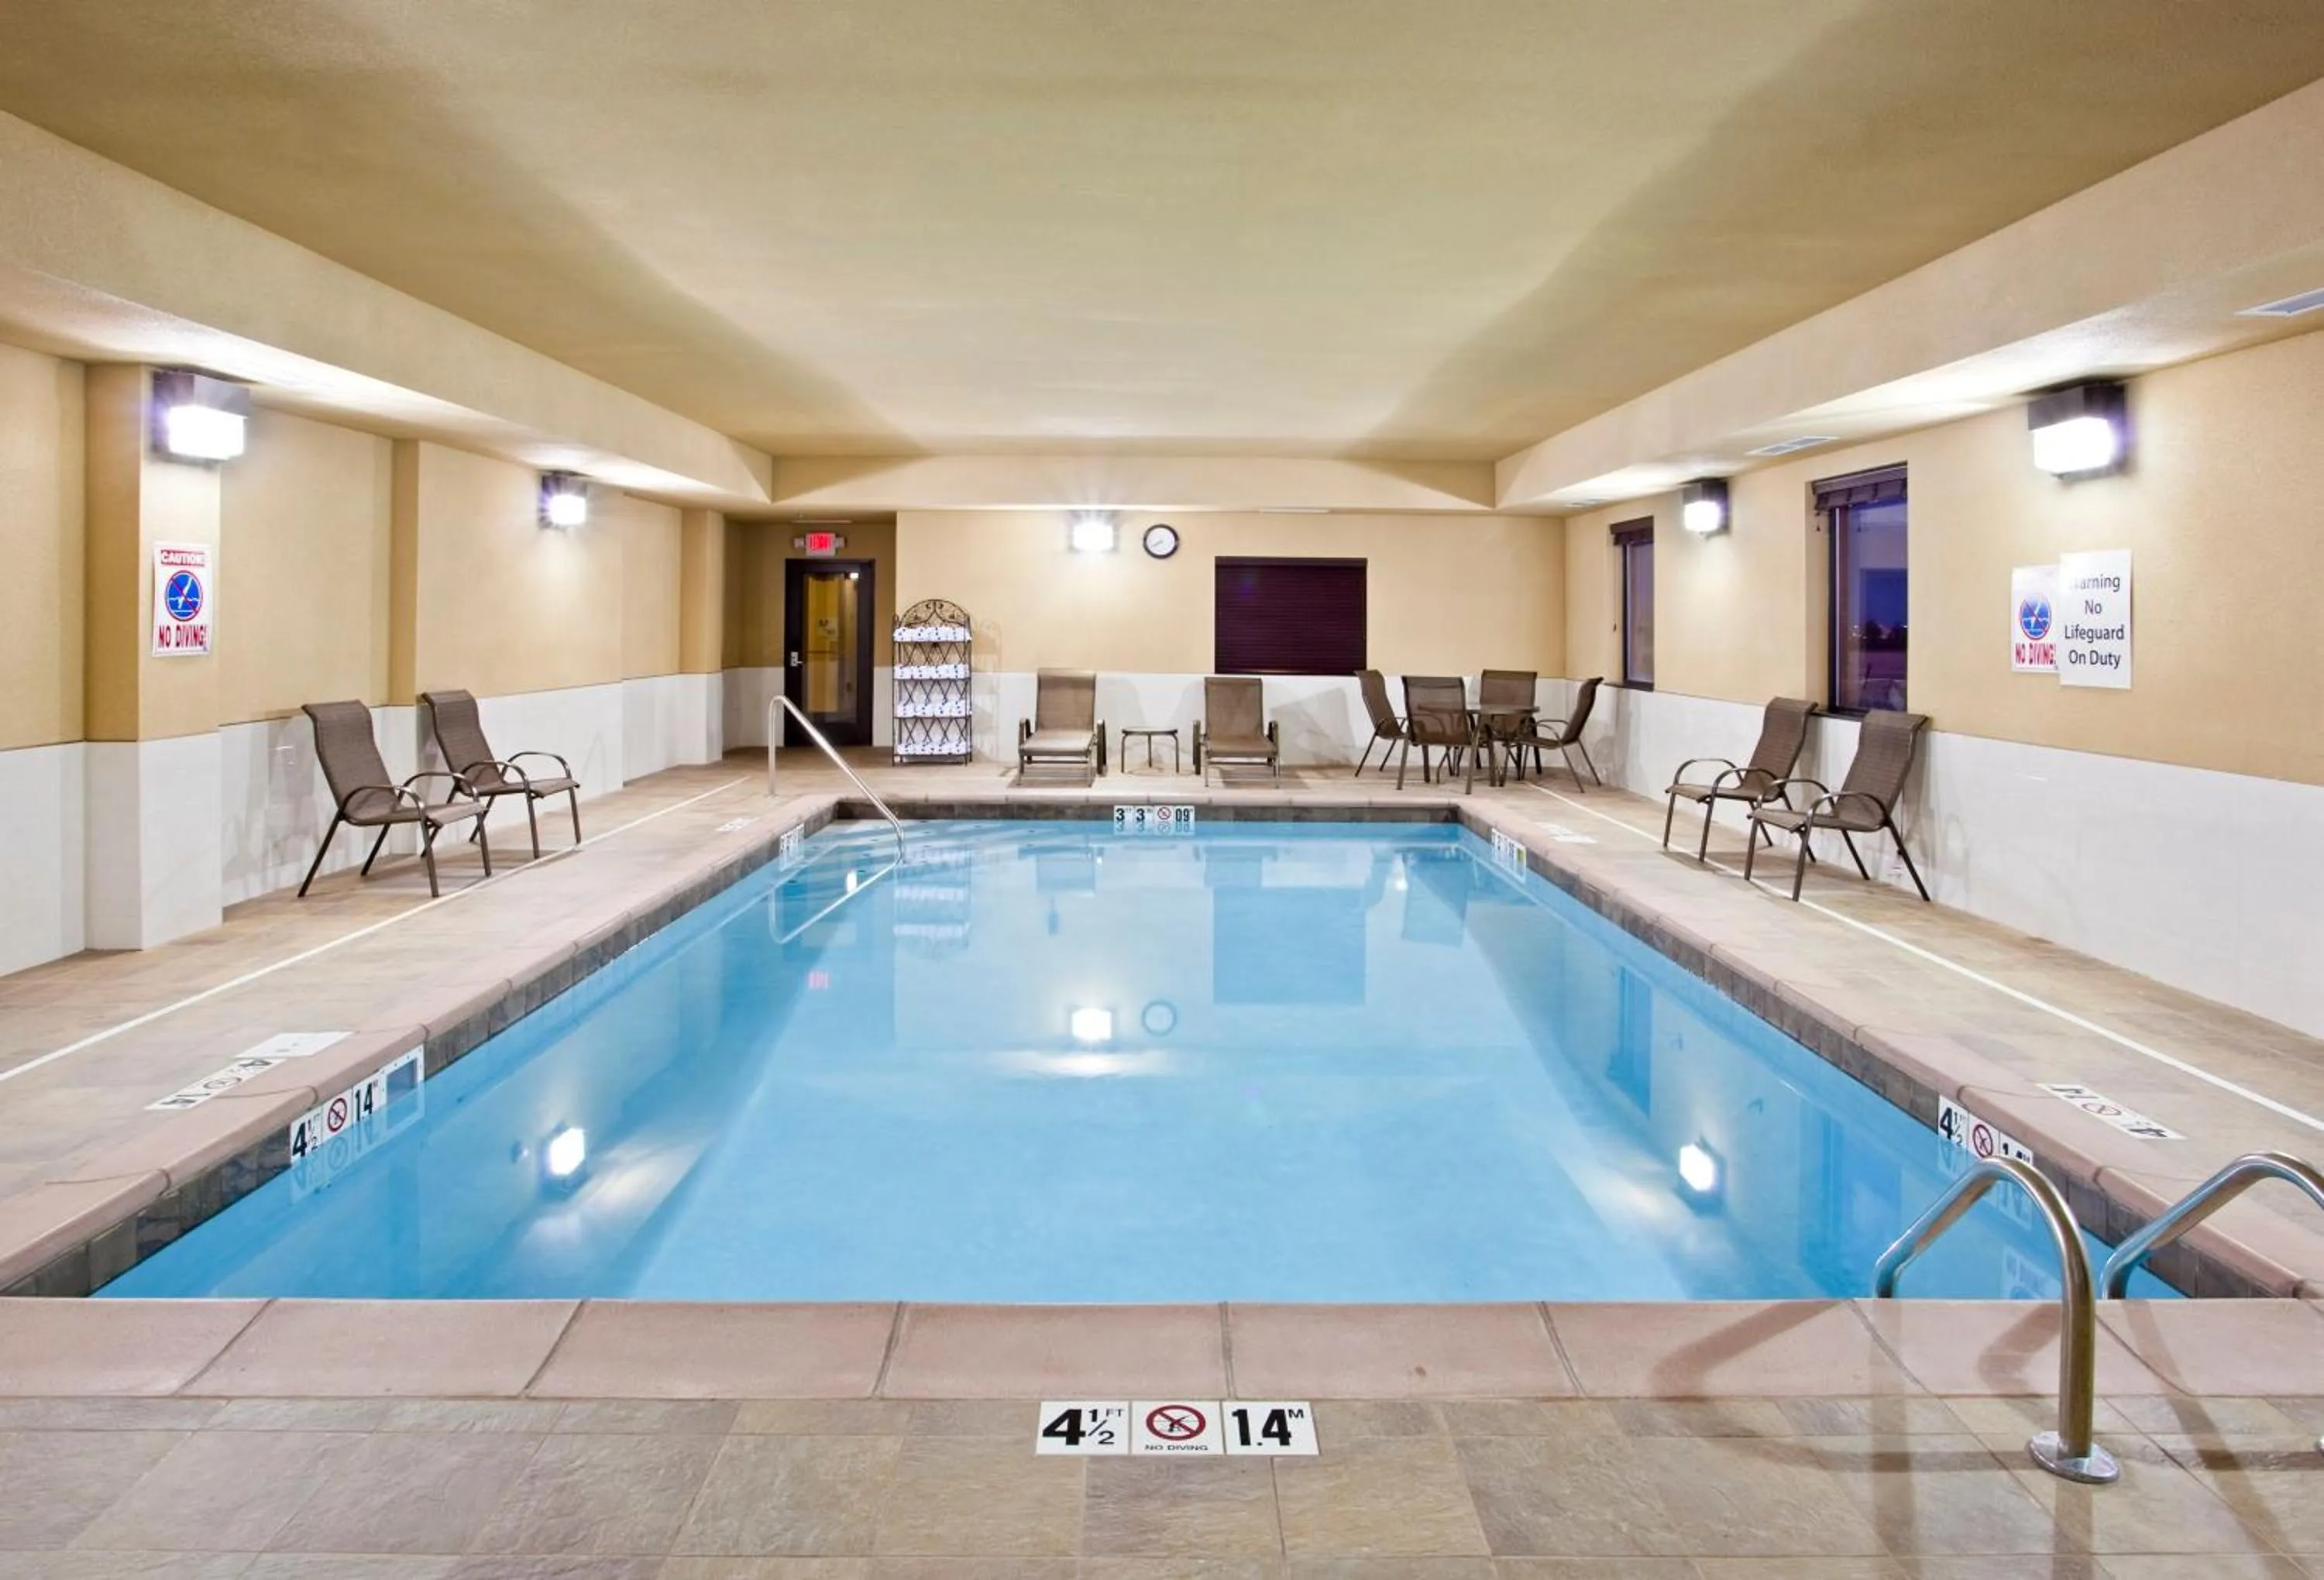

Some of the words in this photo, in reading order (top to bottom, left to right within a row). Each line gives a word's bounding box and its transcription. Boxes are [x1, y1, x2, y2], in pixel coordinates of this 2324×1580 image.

[2071, 574, 2120, 592] arning
[2085, 599, 2102, 614] No
[159, 625, 170, 647] NO
[2064, 624, 2125, 644] Lifeguard
[2016, 643, 2025, 664] NO
[2068, 650, 2086, 664] On
[2089, 650, 2121, 670] Duty
[1116, 808, 1125, 822] 3
[1136, 808, 1145, 822] 3
